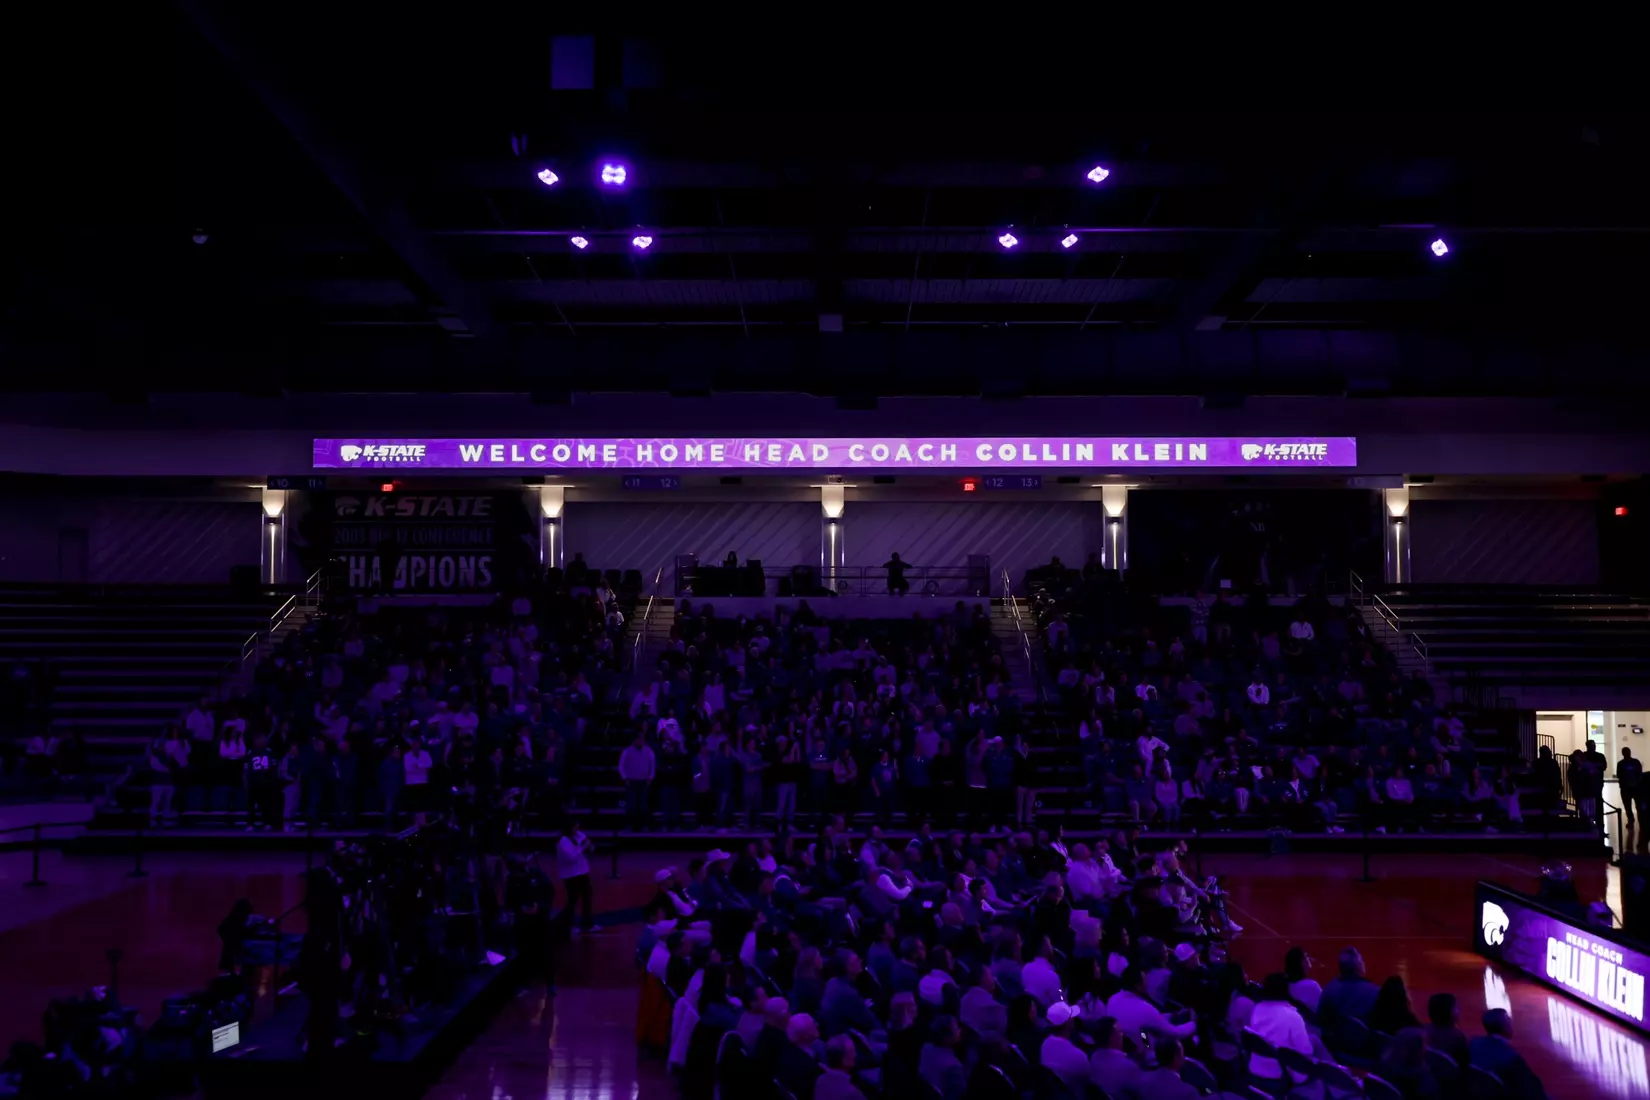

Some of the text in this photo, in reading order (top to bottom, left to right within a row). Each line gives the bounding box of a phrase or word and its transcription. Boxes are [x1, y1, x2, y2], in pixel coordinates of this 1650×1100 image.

[363, 445, 426, 456] K-STATE
[459, 443, 1207, 462] WELCOME HOME HEAD COACH COLLIN KLEIN
[1264, 443, 1328, 455] K-STATE
[661, 477, 672, 488] 12
[992, 477, 1033, 487] 12 13
[364, 496, 494, 517] K-STATE
[252, 755, 270, 770] 24
[1566, 932, 1622, 966] HEAD COACH
[1546, 936, 1596, 998] COLLIN
